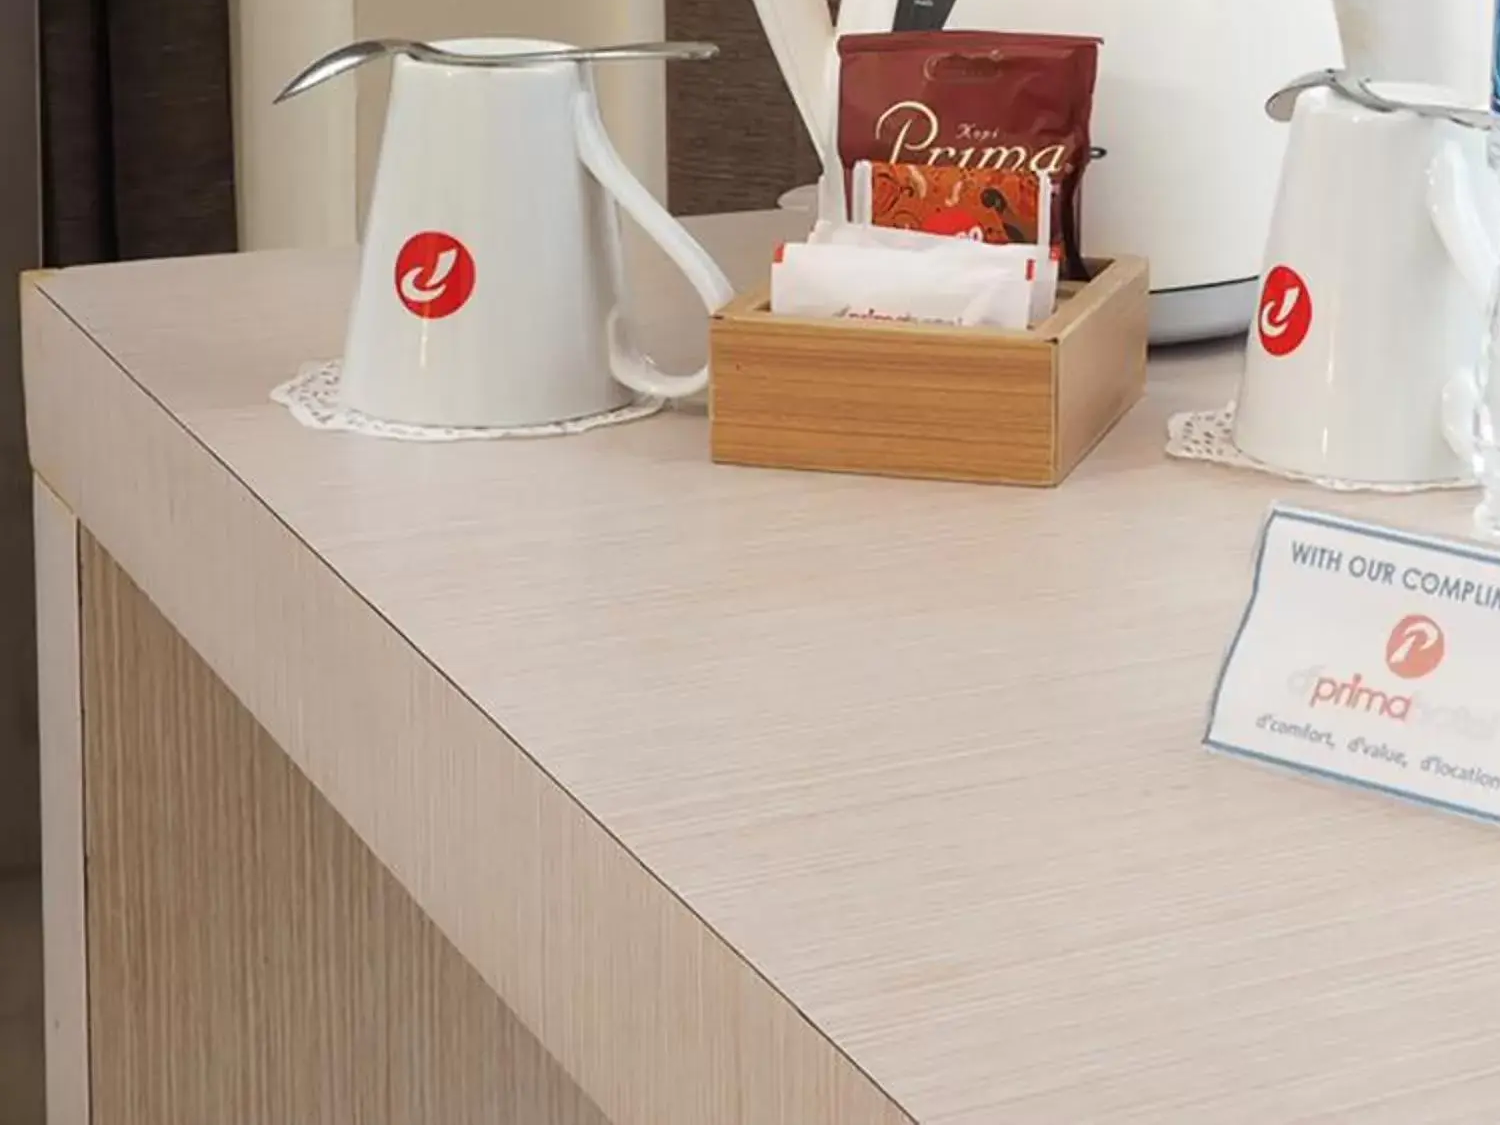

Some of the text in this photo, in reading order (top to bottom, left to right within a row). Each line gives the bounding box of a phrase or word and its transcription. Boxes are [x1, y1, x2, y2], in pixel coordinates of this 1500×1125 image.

[875, 100, 1066, 174] Prima
[1291, 540, 1343, 572] WITH
[1349, 555, 1397, 586] OUR
